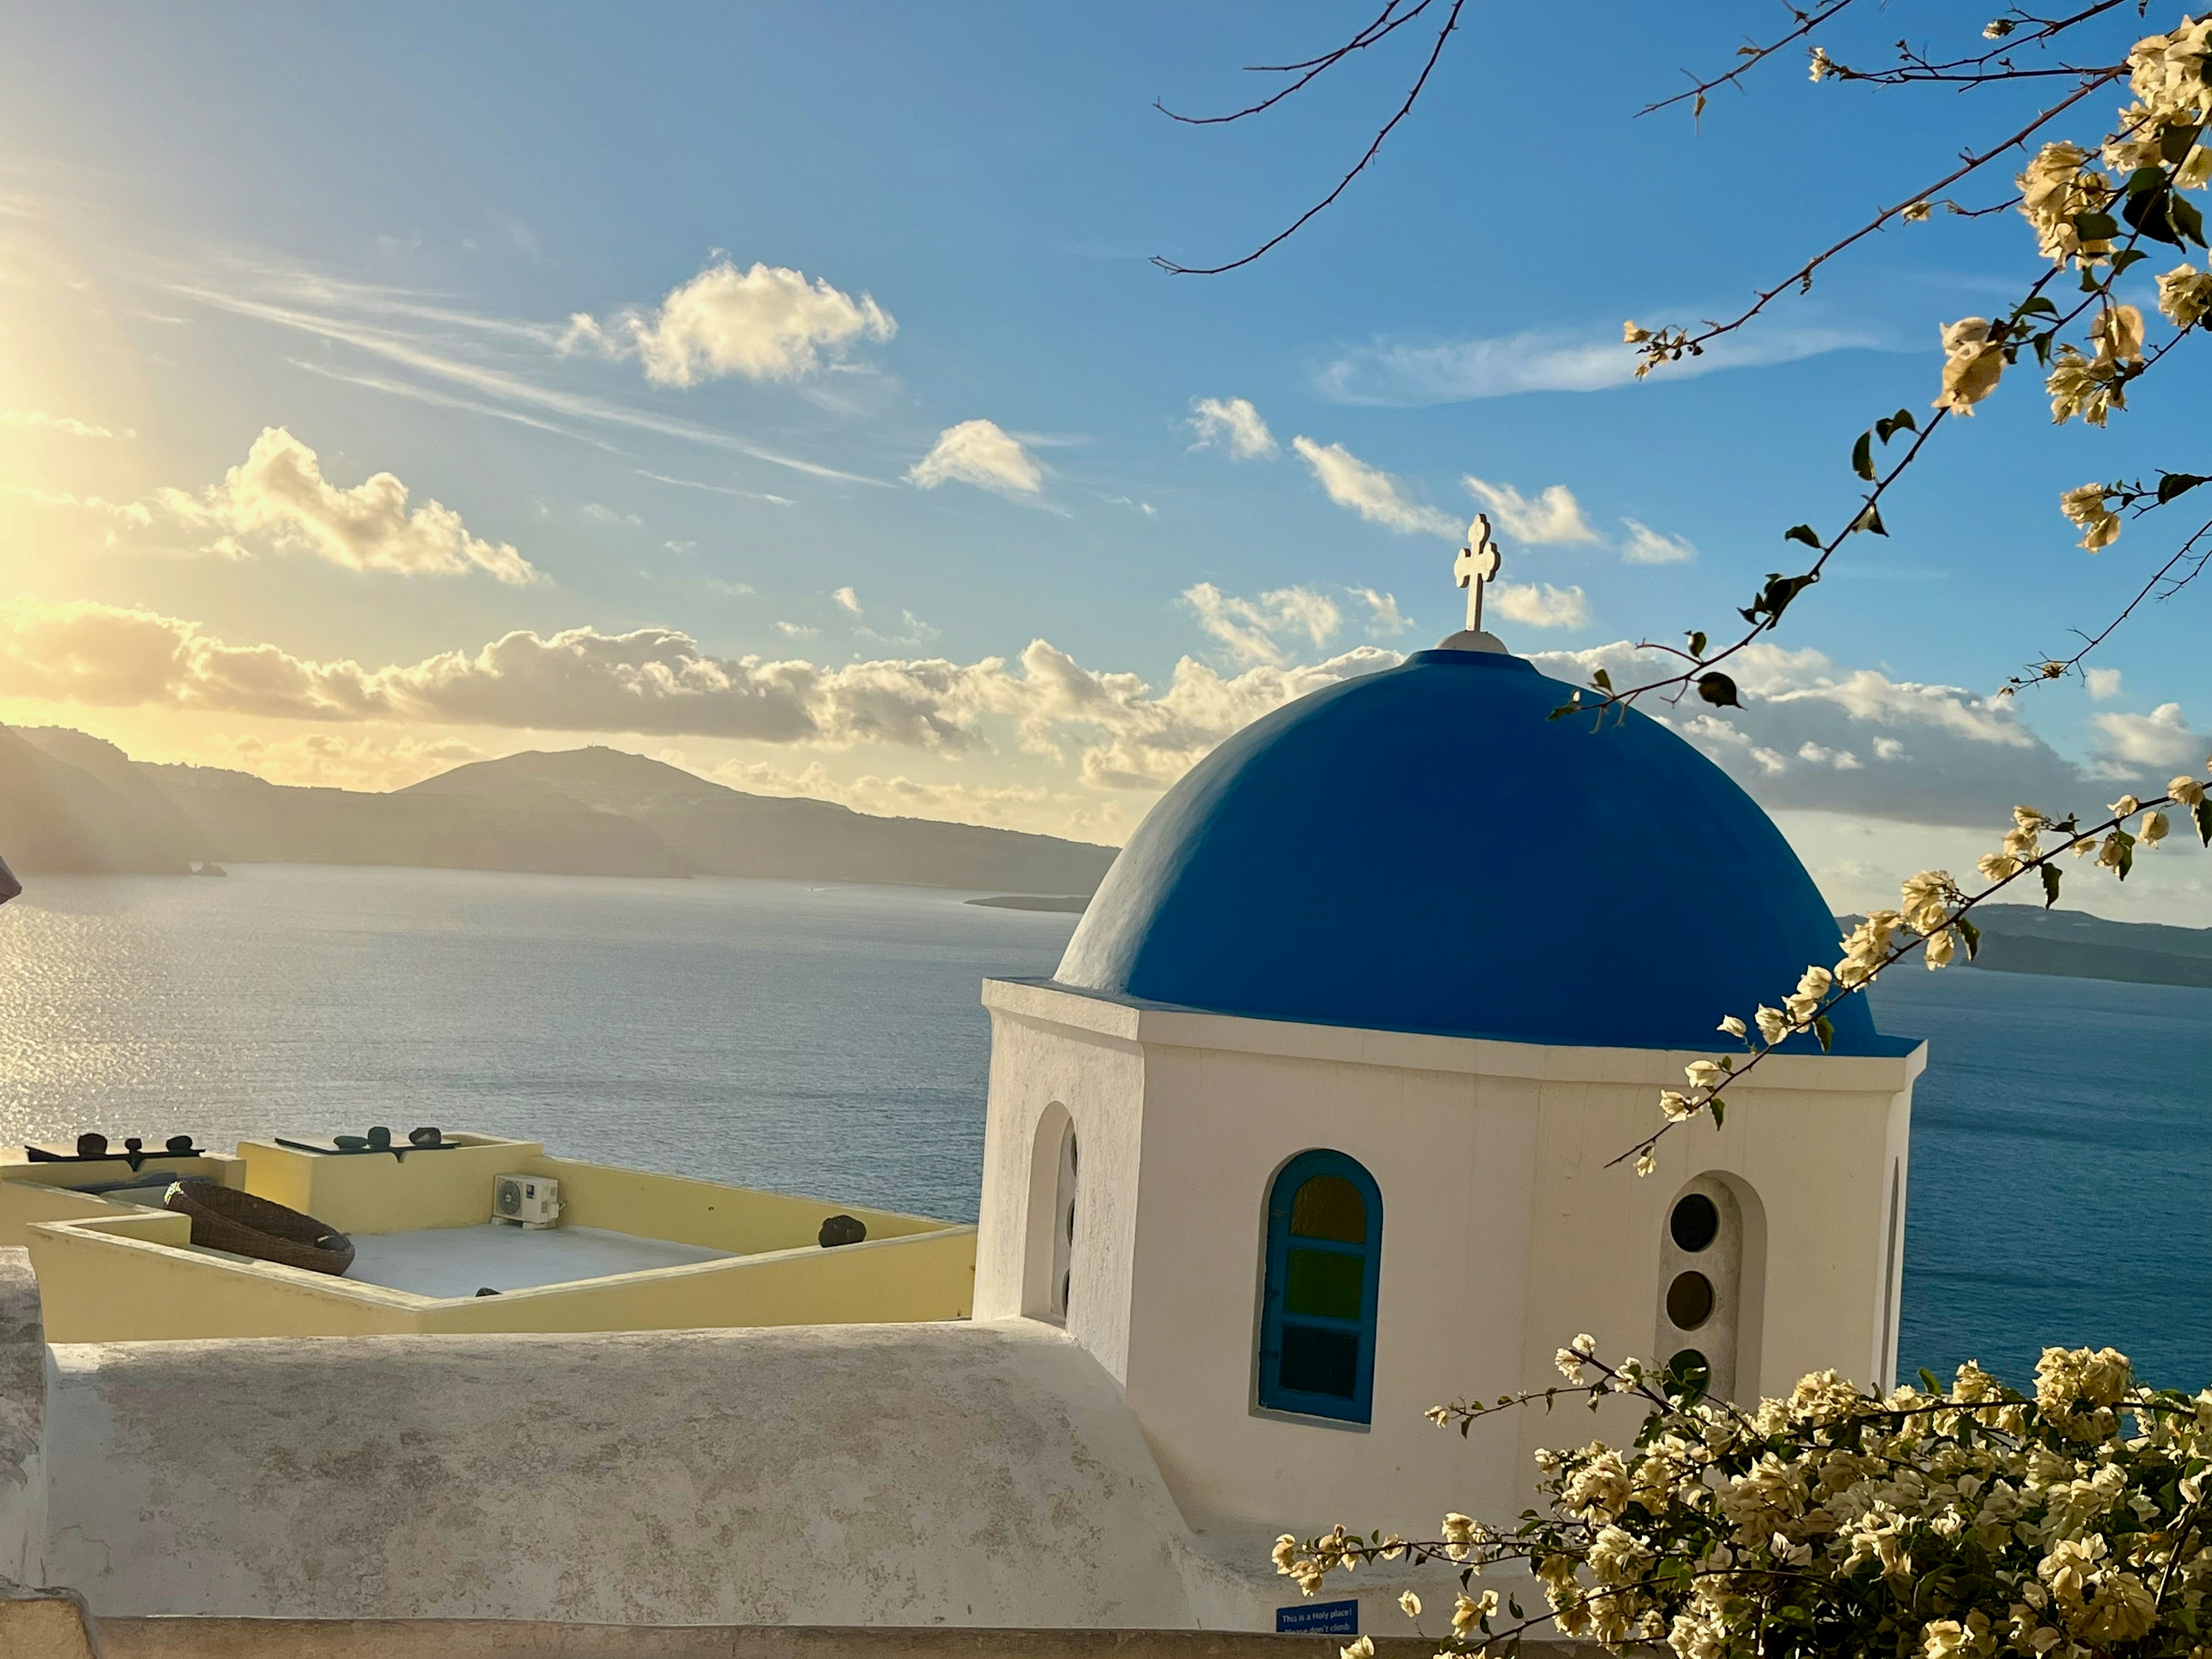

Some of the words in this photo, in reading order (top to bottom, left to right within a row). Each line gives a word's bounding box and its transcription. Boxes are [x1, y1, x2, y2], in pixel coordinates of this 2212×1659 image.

[1282, 1615, 1297, 1623] This
[1312, 1611, 1329, 1620] Holy
[1330, 1607, 1352, 1619] place!
[1309, 1624, 1329, 1633] don't
[1330, 1622, 1350, 1632] climb
